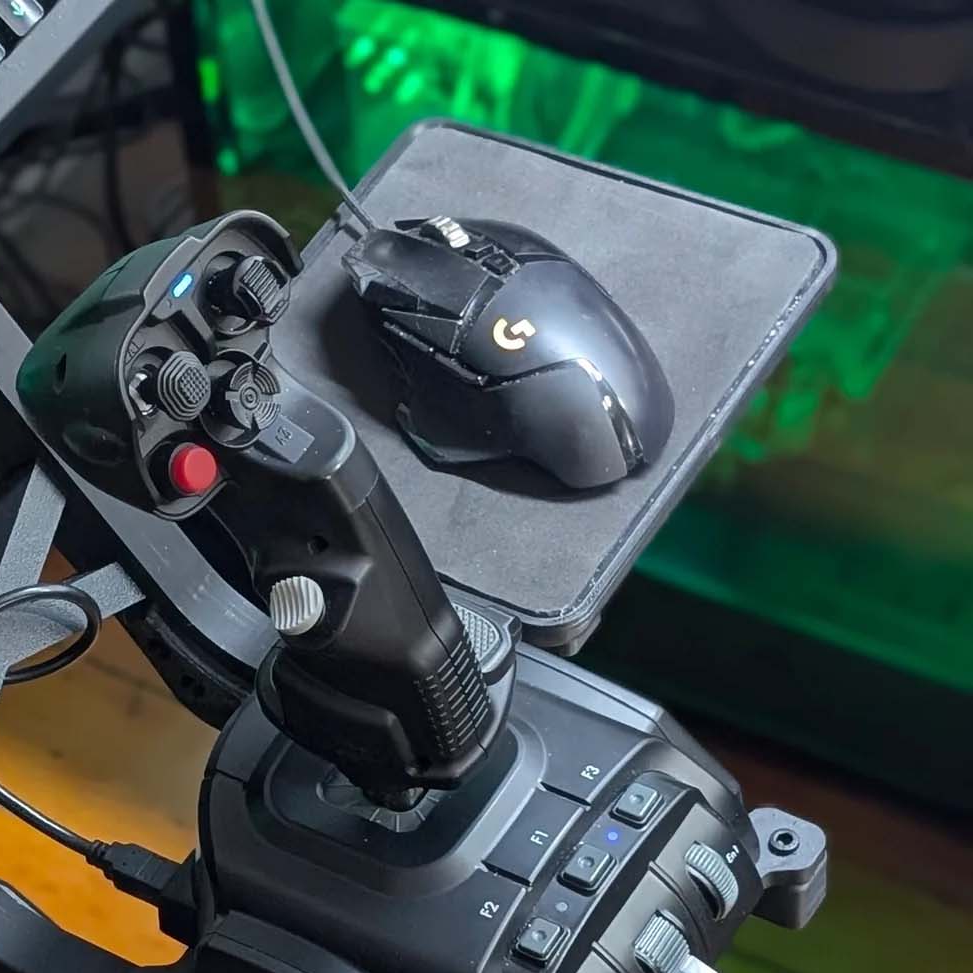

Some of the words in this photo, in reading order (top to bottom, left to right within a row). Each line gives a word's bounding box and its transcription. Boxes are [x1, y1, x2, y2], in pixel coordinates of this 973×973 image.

[580, 764, 601, 781] F3
[530, 829, 550, 846] F1
[479, 900, 500, 919] F2
